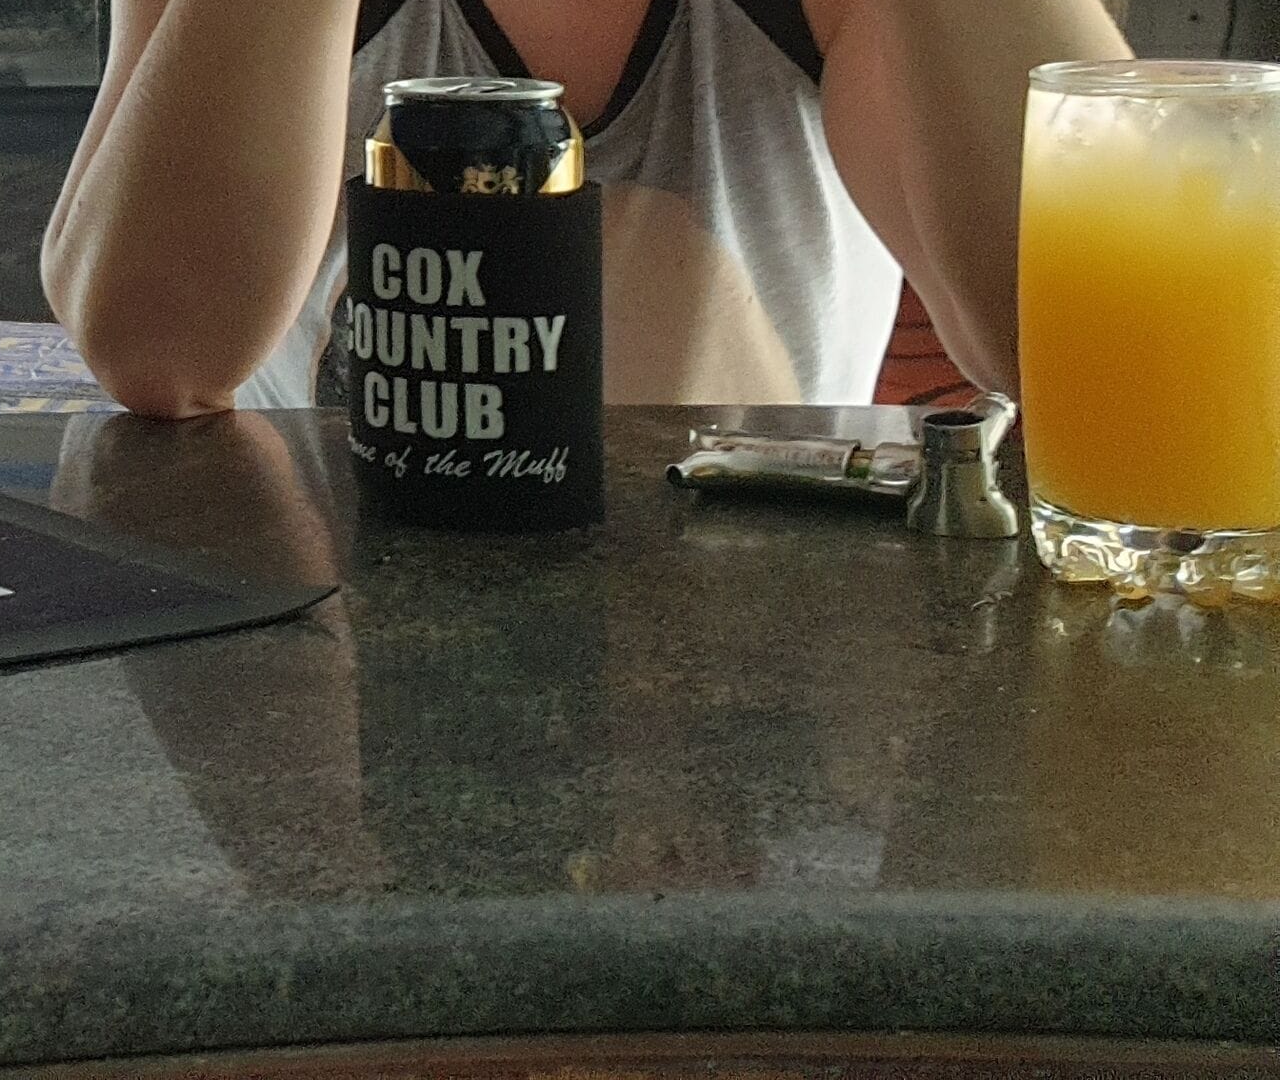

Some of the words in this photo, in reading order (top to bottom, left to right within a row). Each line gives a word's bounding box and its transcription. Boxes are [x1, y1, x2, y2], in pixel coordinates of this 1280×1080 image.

[372, 243, 487, 307] COX
[364, 371, 505, 440] CLUB
[384, 446, 411, 478] of
[424, 449, 472, 478] the
[483, 446, 569, 483] Muff
